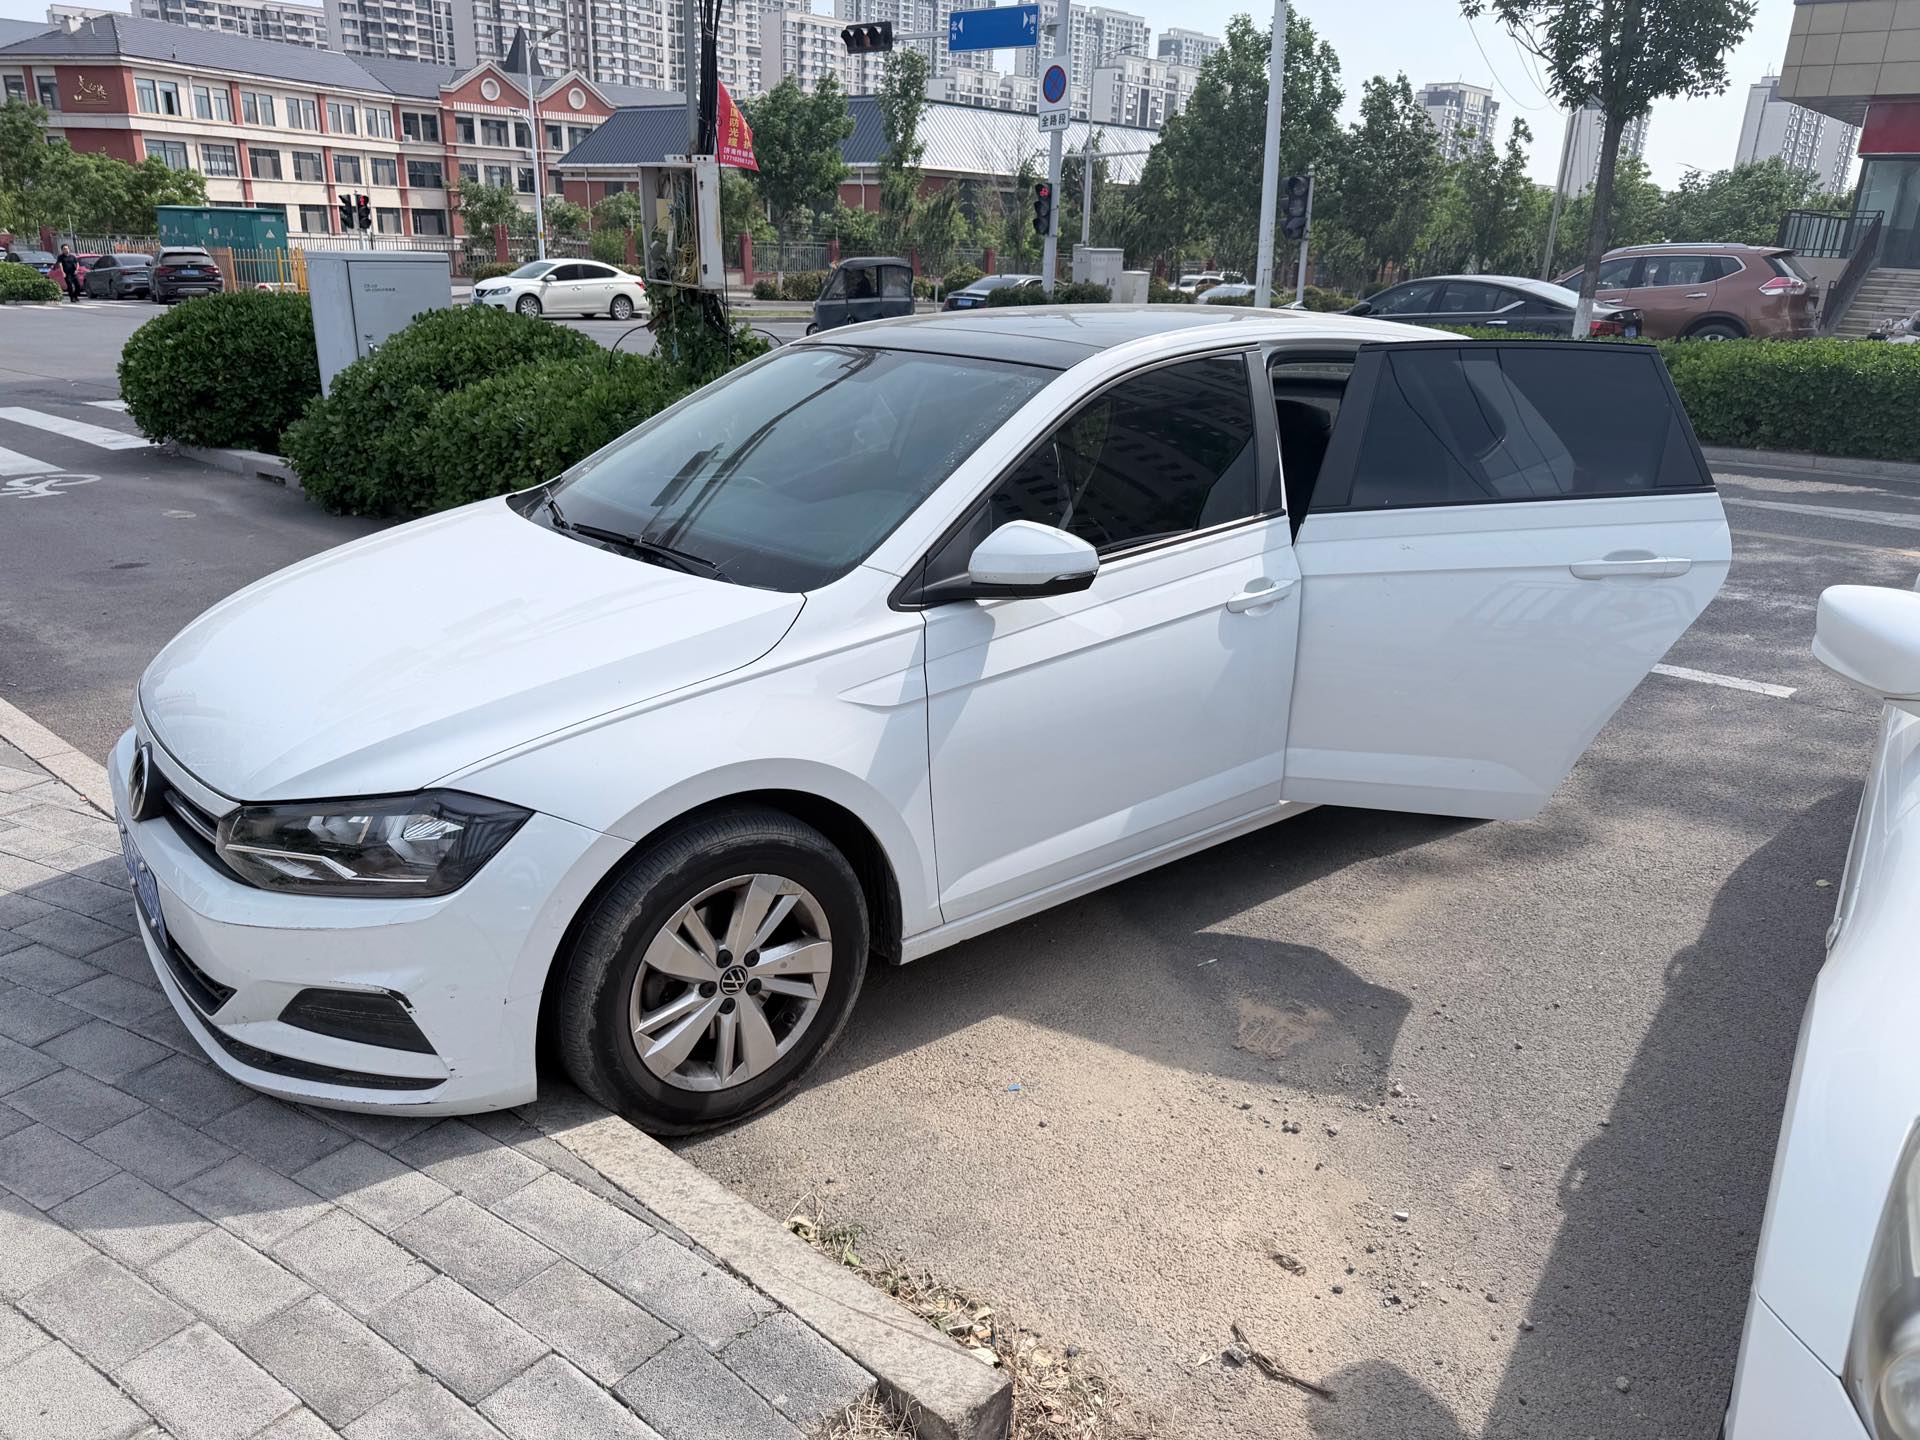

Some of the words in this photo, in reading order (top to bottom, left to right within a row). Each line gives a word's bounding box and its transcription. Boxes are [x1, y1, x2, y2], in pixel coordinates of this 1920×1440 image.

[1029, 25, 1035, 35] S
[951, 33, 957, 41] N
[1041, 113, 1066, 127] 全路段
